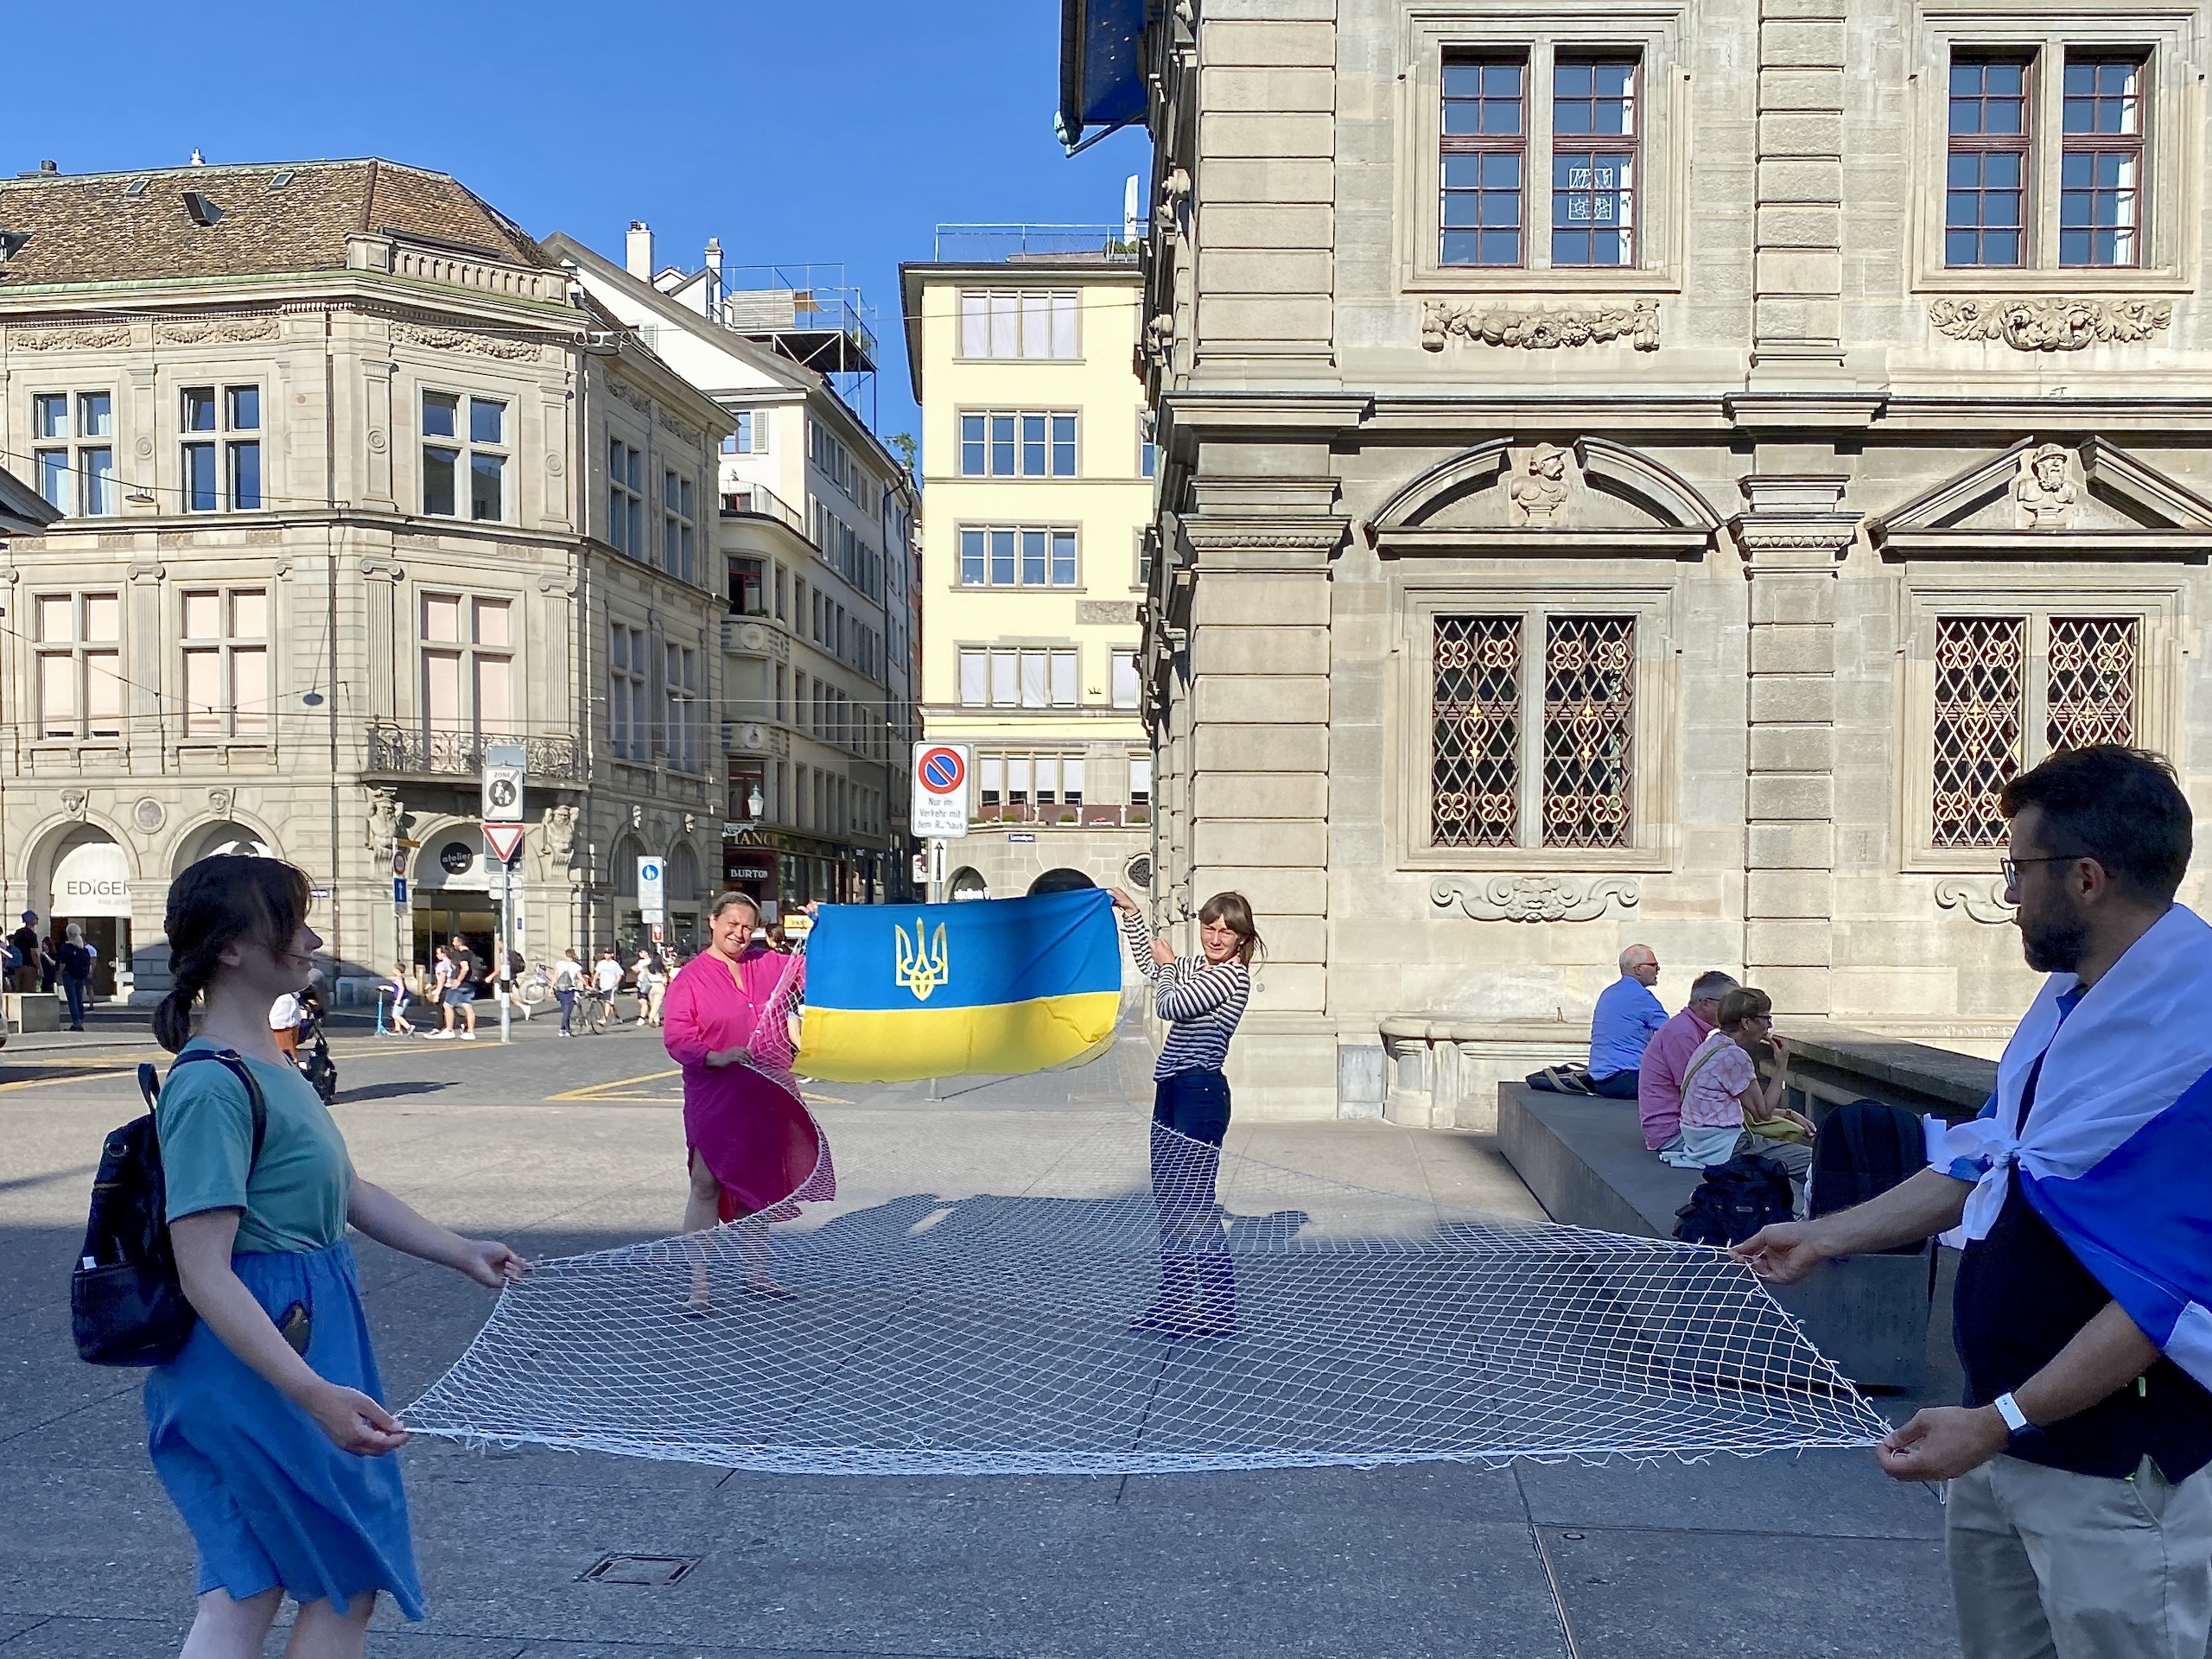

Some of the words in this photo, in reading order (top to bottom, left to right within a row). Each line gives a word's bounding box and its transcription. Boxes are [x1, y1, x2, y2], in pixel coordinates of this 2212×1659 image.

[928, 797, 941, 805] Nur
[919, 808, 947, 817] Verkehr
[949, 810, 961, 818] mit
[917, 820, 931, 829] dem
[442, 852, 471, 863] atelier
[730, 868, 768, 879] BURTON
